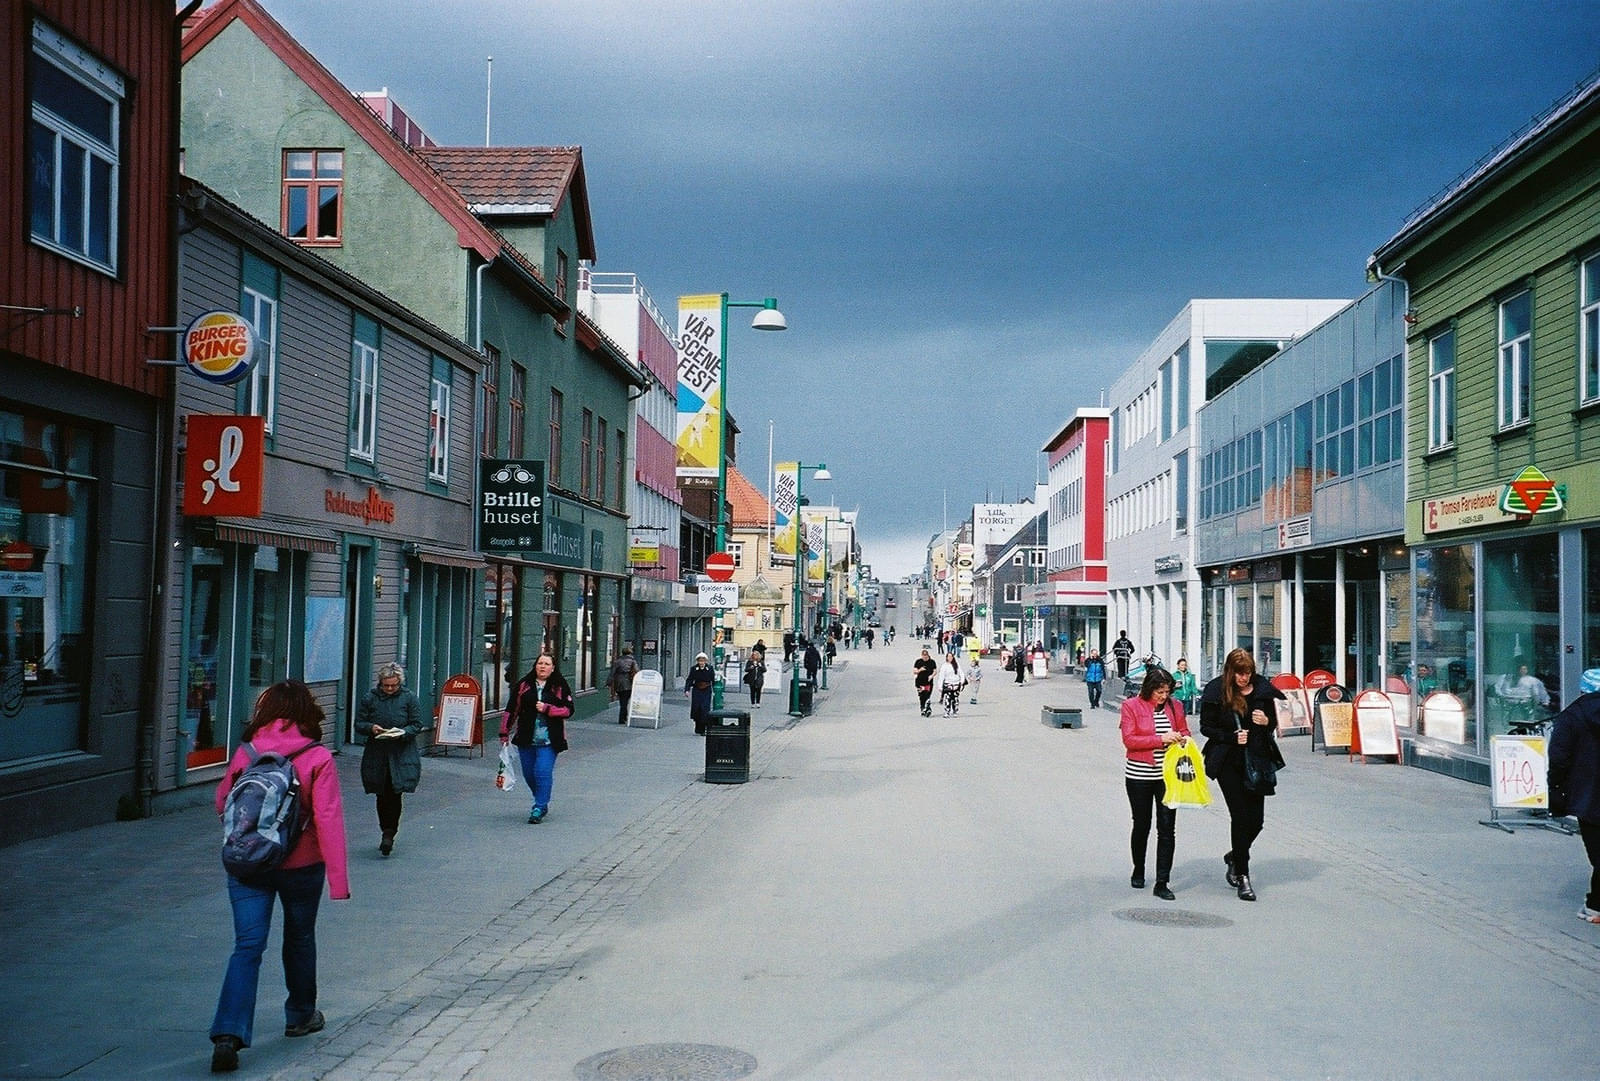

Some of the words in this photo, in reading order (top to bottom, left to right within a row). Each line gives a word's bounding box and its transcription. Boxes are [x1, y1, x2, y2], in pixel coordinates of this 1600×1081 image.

[188, 324, 247, 346] BURGER
[684, 313, 716, 345] VÅR
[188, 338, 248, 363] KING
[677, 333, 722, 377] SCENE
[677, 357, 717, 392] FEST
[778, 473, 796, 490] VÅR
[483, 491, 542, 507] Brille
[775, 497, 796, 516] FEST
[1461, 489, 1498, 513] Farvehandel
[483, 508, 541, 525] huset
[978, 517, 1016, 525] TORGET
[700, 584, 722, 593] Gjelder
[723, 585, 736, 593] ikke
